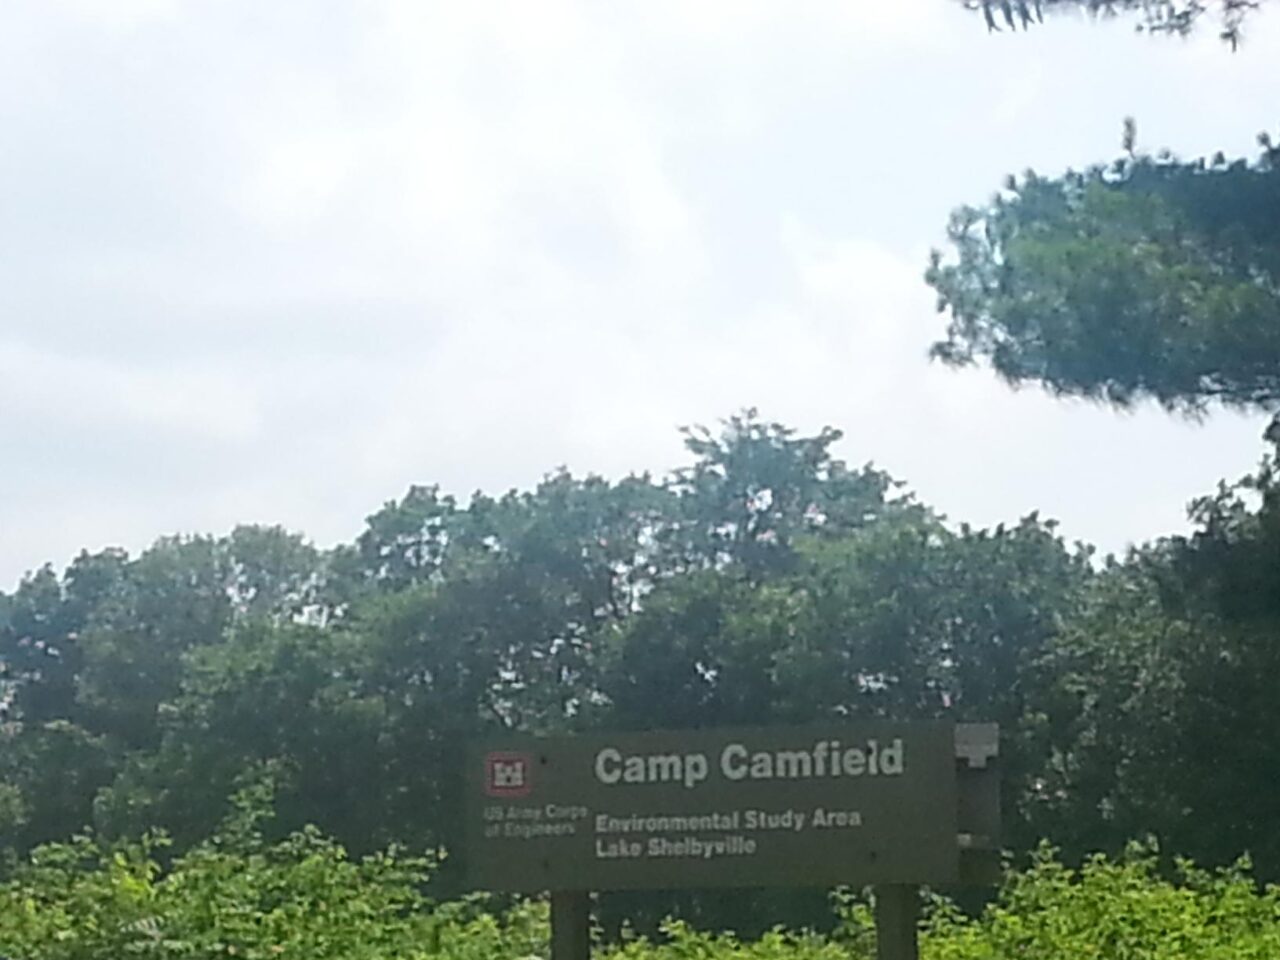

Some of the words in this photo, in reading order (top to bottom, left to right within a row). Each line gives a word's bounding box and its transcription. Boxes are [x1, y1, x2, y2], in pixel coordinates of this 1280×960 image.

[595, 748, 708, 787] Camp
[721, 739, 903, 780] Camfield
[596, 811, 738, 832] Environmental
[745, 810, 805, 831] Study
[812, 808, 861, 827] Area
[596, 839, 642, 858] Lake
[648, 836, 756, 858] Shelbyville
